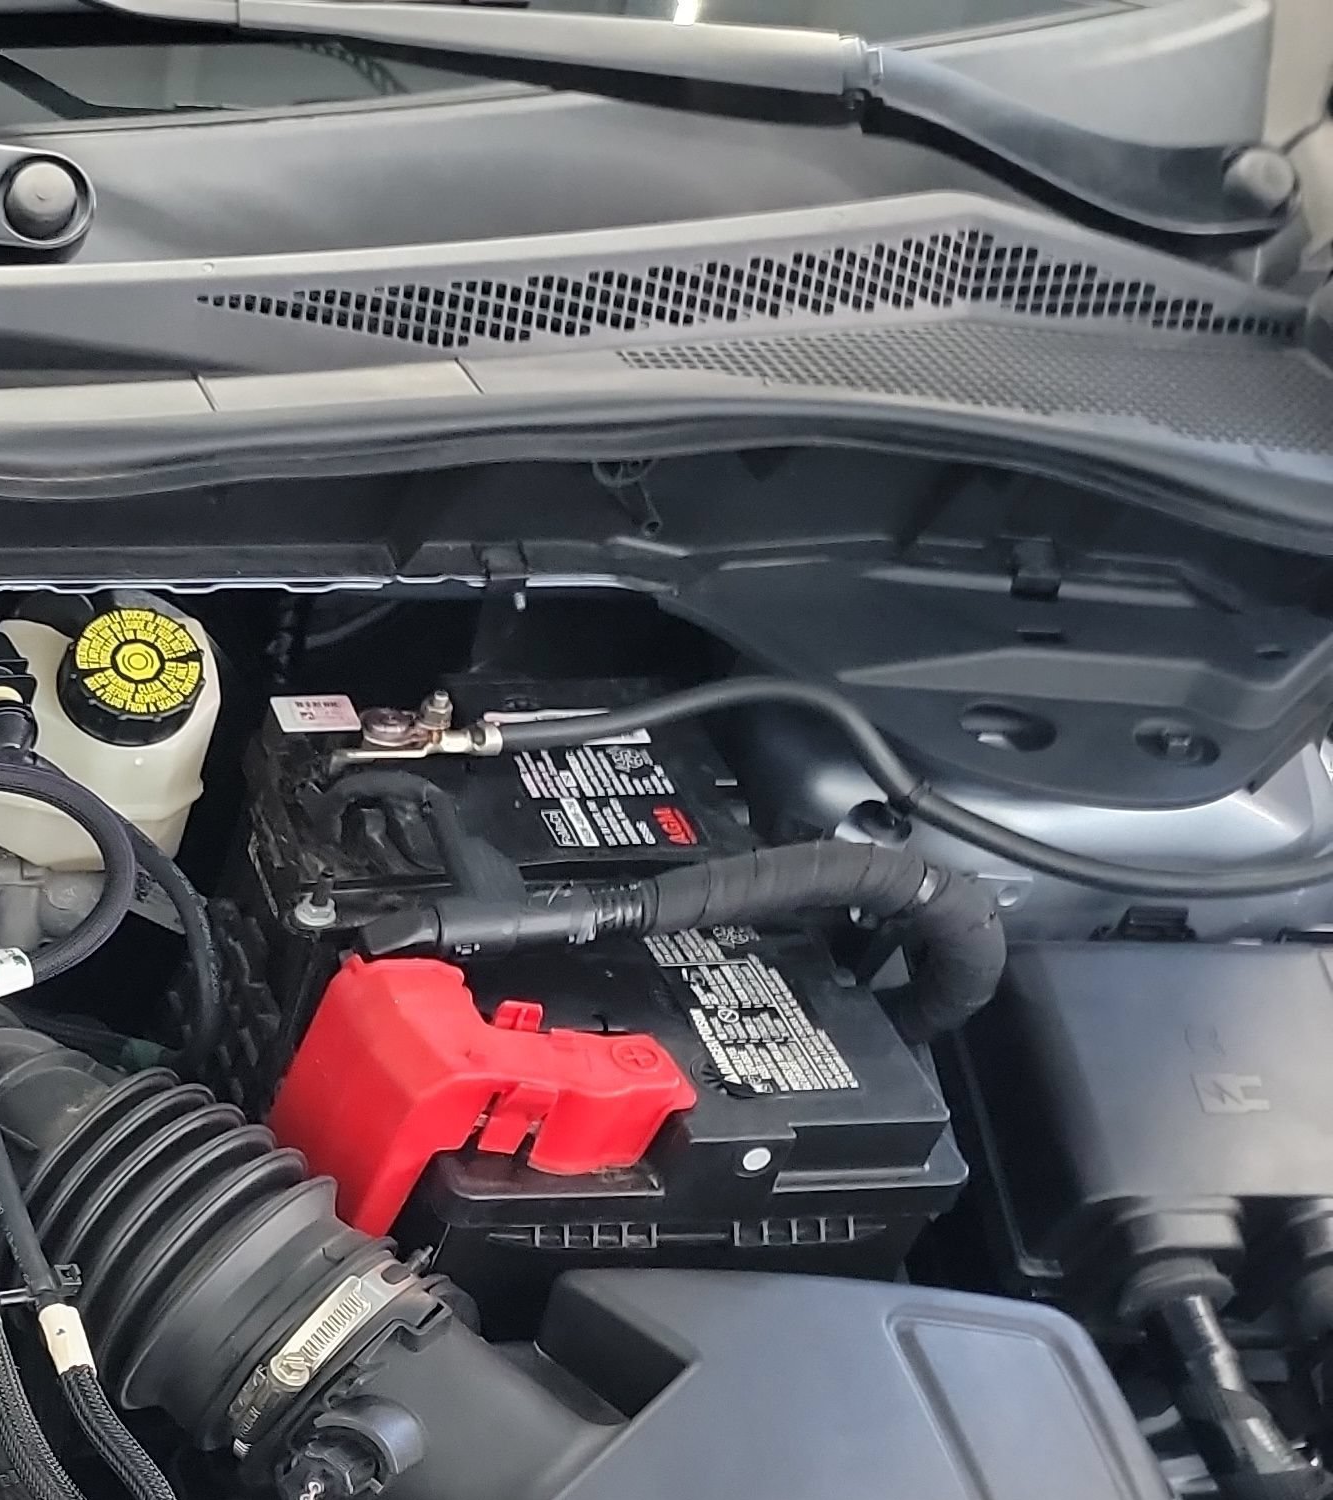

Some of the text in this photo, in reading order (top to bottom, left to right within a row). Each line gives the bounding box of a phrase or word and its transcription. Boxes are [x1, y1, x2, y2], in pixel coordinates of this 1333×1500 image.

[92, 671, 109, 687] CAP
[102, 683, 132, 702] BEFORE
[134, 685, 171, 704] REMOVING
[137, 678, 164, 694] CLEAN
[100, 692, 124, 708] FLUID
[124, 701, 147, 712] FROM
[155, 690, 184, 710] SEALED
